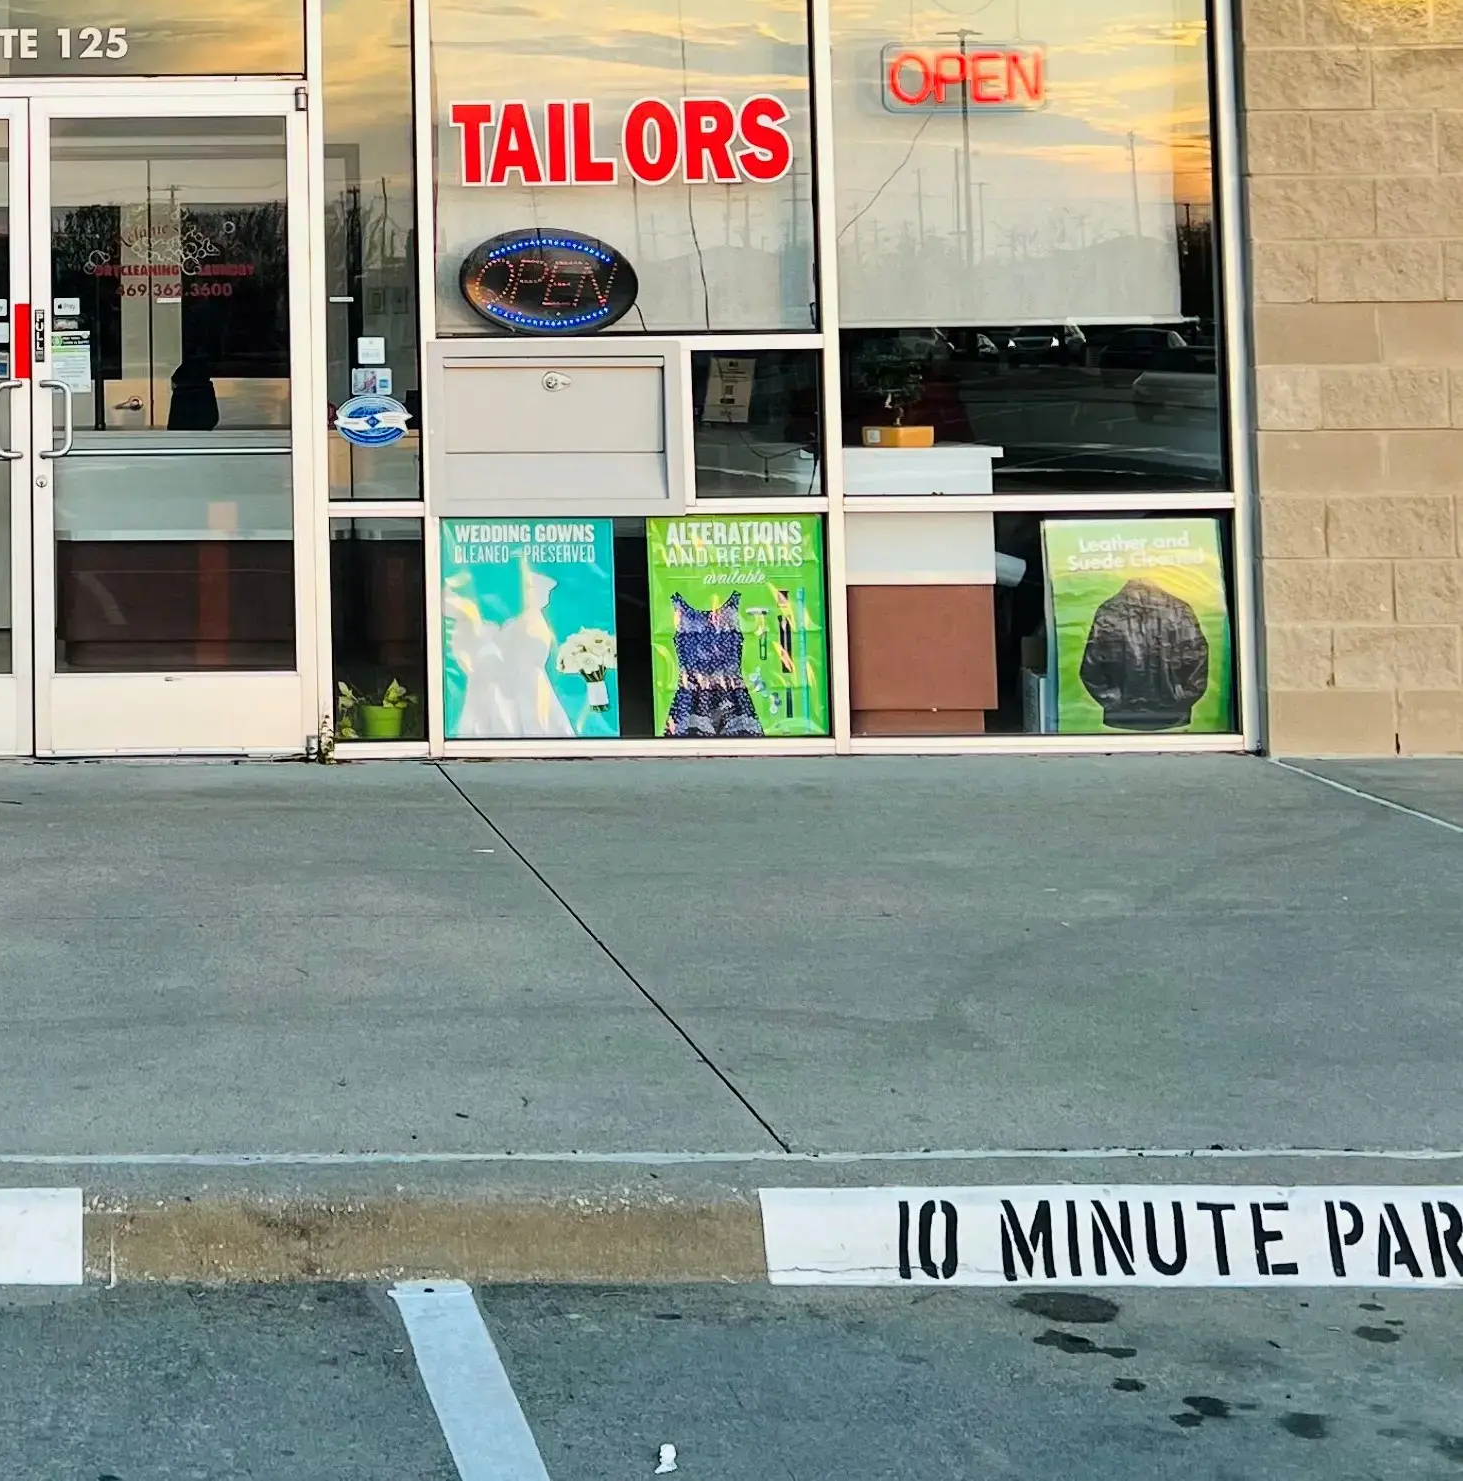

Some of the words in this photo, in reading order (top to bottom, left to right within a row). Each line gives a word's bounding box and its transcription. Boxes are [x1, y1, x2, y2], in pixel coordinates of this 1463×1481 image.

[57, 27, 129, 59] 125
[888, 50, 1044, 105] OPEN
[449, 94, 793, 187] TAILORS
[475, 258, 618, 308] OPEN
[35, 313, 44, 351] PULL
[454, 524, 531, 543] WEDDING
[535, 523, 595, 543] GOWNS
[666, 521, 803, 546] ALTERATIONS
[1078, 534, 1149, 554] Leather
[1153, 530, 1190, 549] and
[454, 544, 509, 564] CLEANED
[522, 544, 596, 564] PRESERVED
[667, 546, 709, 568] AND
[716, 545, 803, 568] REPAIRS
[1067, 553, 1126, 571] Suede
[703, 569, 767, 585] available
[897, 1199, 958, 1279] 10
[1000, 1199, 1298, 1281] MINUTE
[1323, 1200, 1463, 1278] PAR
